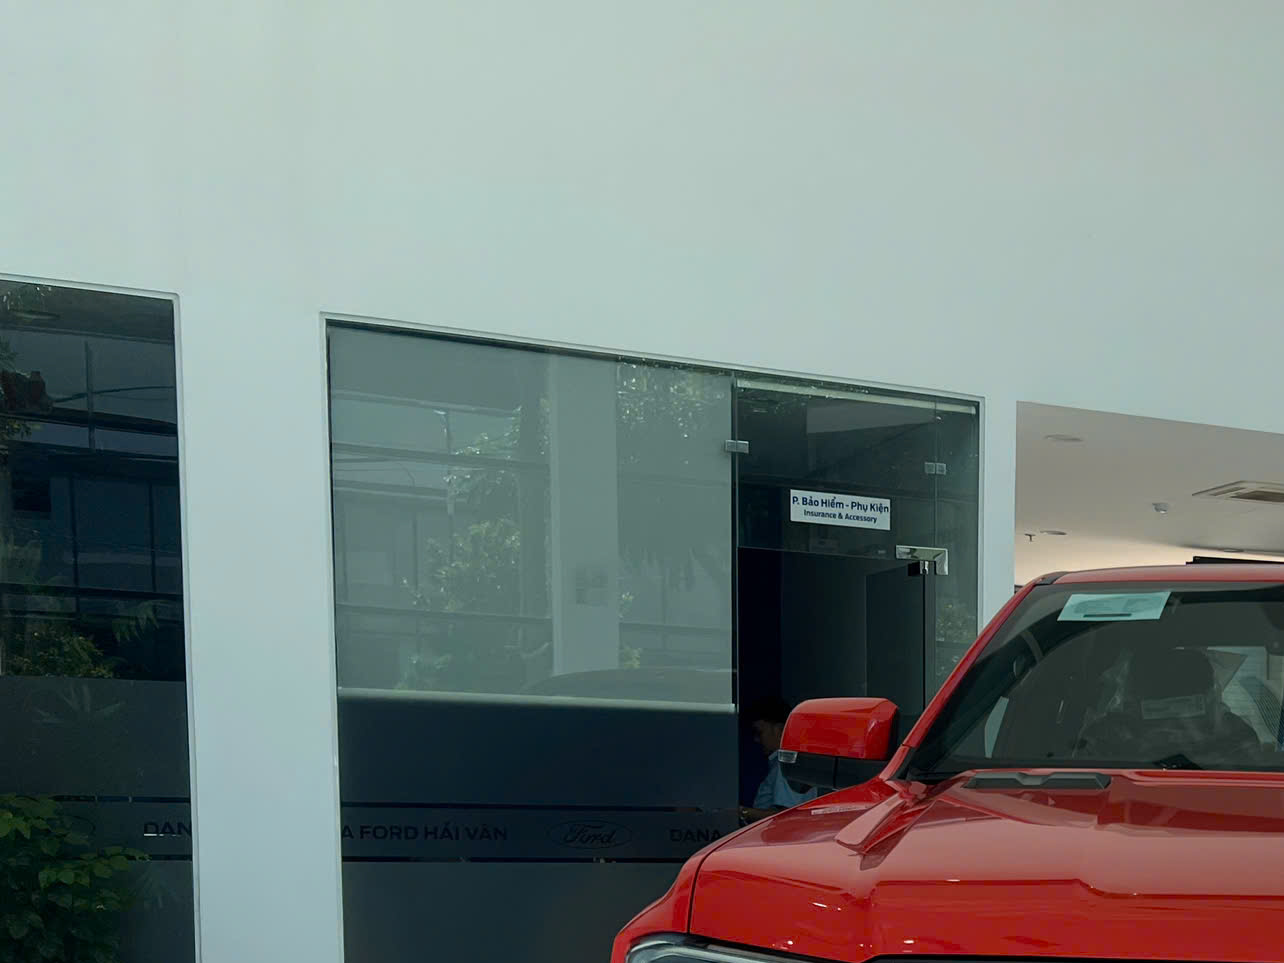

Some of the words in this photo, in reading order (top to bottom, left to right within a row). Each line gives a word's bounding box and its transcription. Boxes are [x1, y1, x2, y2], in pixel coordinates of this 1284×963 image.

[792, 495, 800, 505] P.
[801, 495, 819, 507] Bảo
[820, 496, 845, 509] Hiểm
[850, 501, 868, 513] Phụ
[869, 502, 889, 514] Kiện
[803, 509, 837, 519] Insurance
[837, 512, 843, 520] &
[844, 513, 878, 524] Accessory
[359, 824, 419, 840] FORD
[563, 823, 617, 843] Ford
[669, 828, 721, 843] DANA
